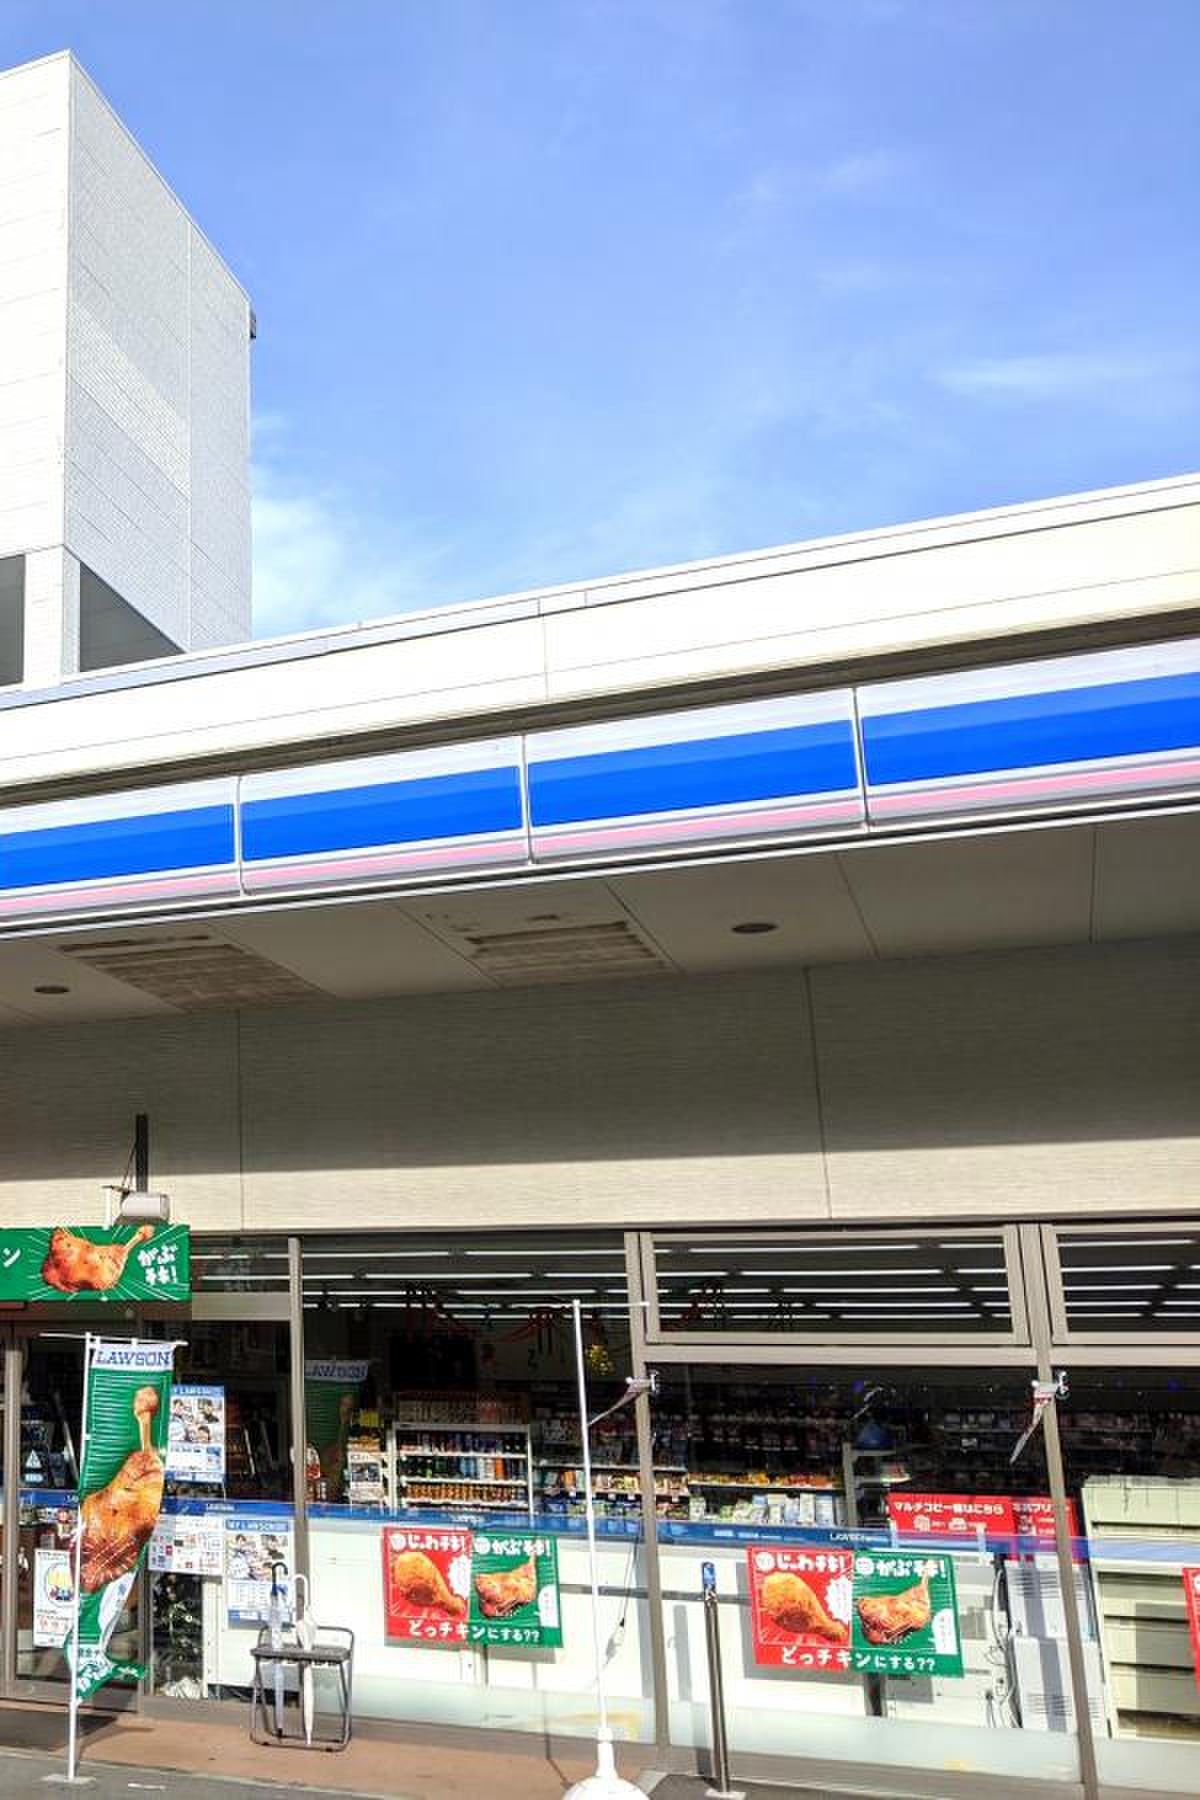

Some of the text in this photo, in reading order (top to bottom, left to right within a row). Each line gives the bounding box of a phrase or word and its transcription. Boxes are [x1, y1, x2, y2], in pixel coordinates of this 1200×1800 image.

[95, 1351, 171, 1366] LAWSON
[408, 1620, 540, 1642] どっチキンにする??
[782, 1646, 935, 1671] どっチキンにする??
